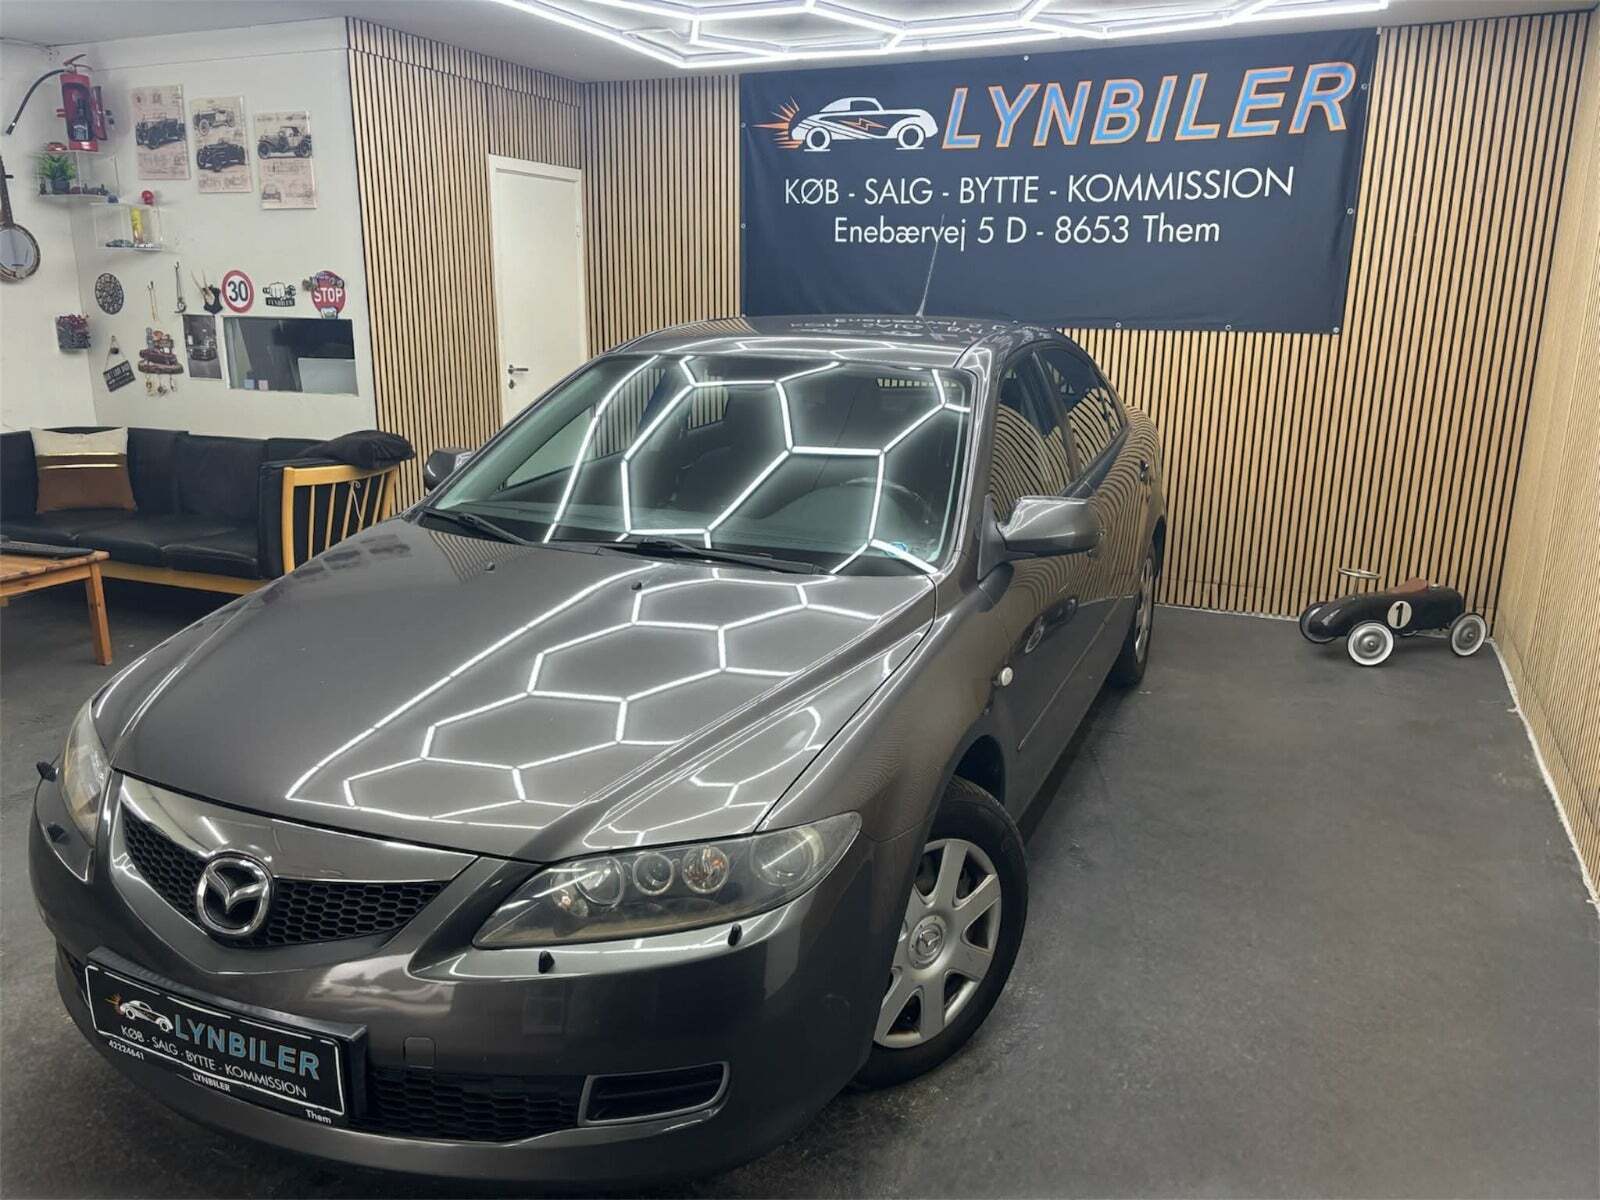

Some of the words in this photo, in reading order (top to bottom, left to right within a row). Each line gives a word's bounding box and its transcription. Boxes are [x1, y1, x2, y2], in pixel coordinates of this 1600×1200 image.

[942, 61, 1356, 150] LYNBILER
[785, 178, 839, 204] KØB
[864, 177, 933, 204] SALG
[960, 175, 1039, 203] BYTTE
[1068, 166, 1295, 203] KOMMISSION
[834, 215, 967, 252] Enebærvej
[977, 217, 995, 243] 5
[1007, 217, 1026, 243] D
[1054, 216, 1129, 243] 8653
[1143, 213, 1220, 243] Them
[227, 281, 248, 302] 30
[314, 287, 343, 302] STOP
[1396, 603, 1404, 626] 1
[121, 1025, 145, 1042] KØB
[152, 1036, 178, 1056] SALG
[186, 1050, 215, 1071] BYTTE
[225, 1063, 307, 1098] KOMMISSION
[174, 1014, 320, 1080] LYNBILER
[193, 1072, 231, 1093] LYNBILER
[306, 1110, 332, 1124] Them
